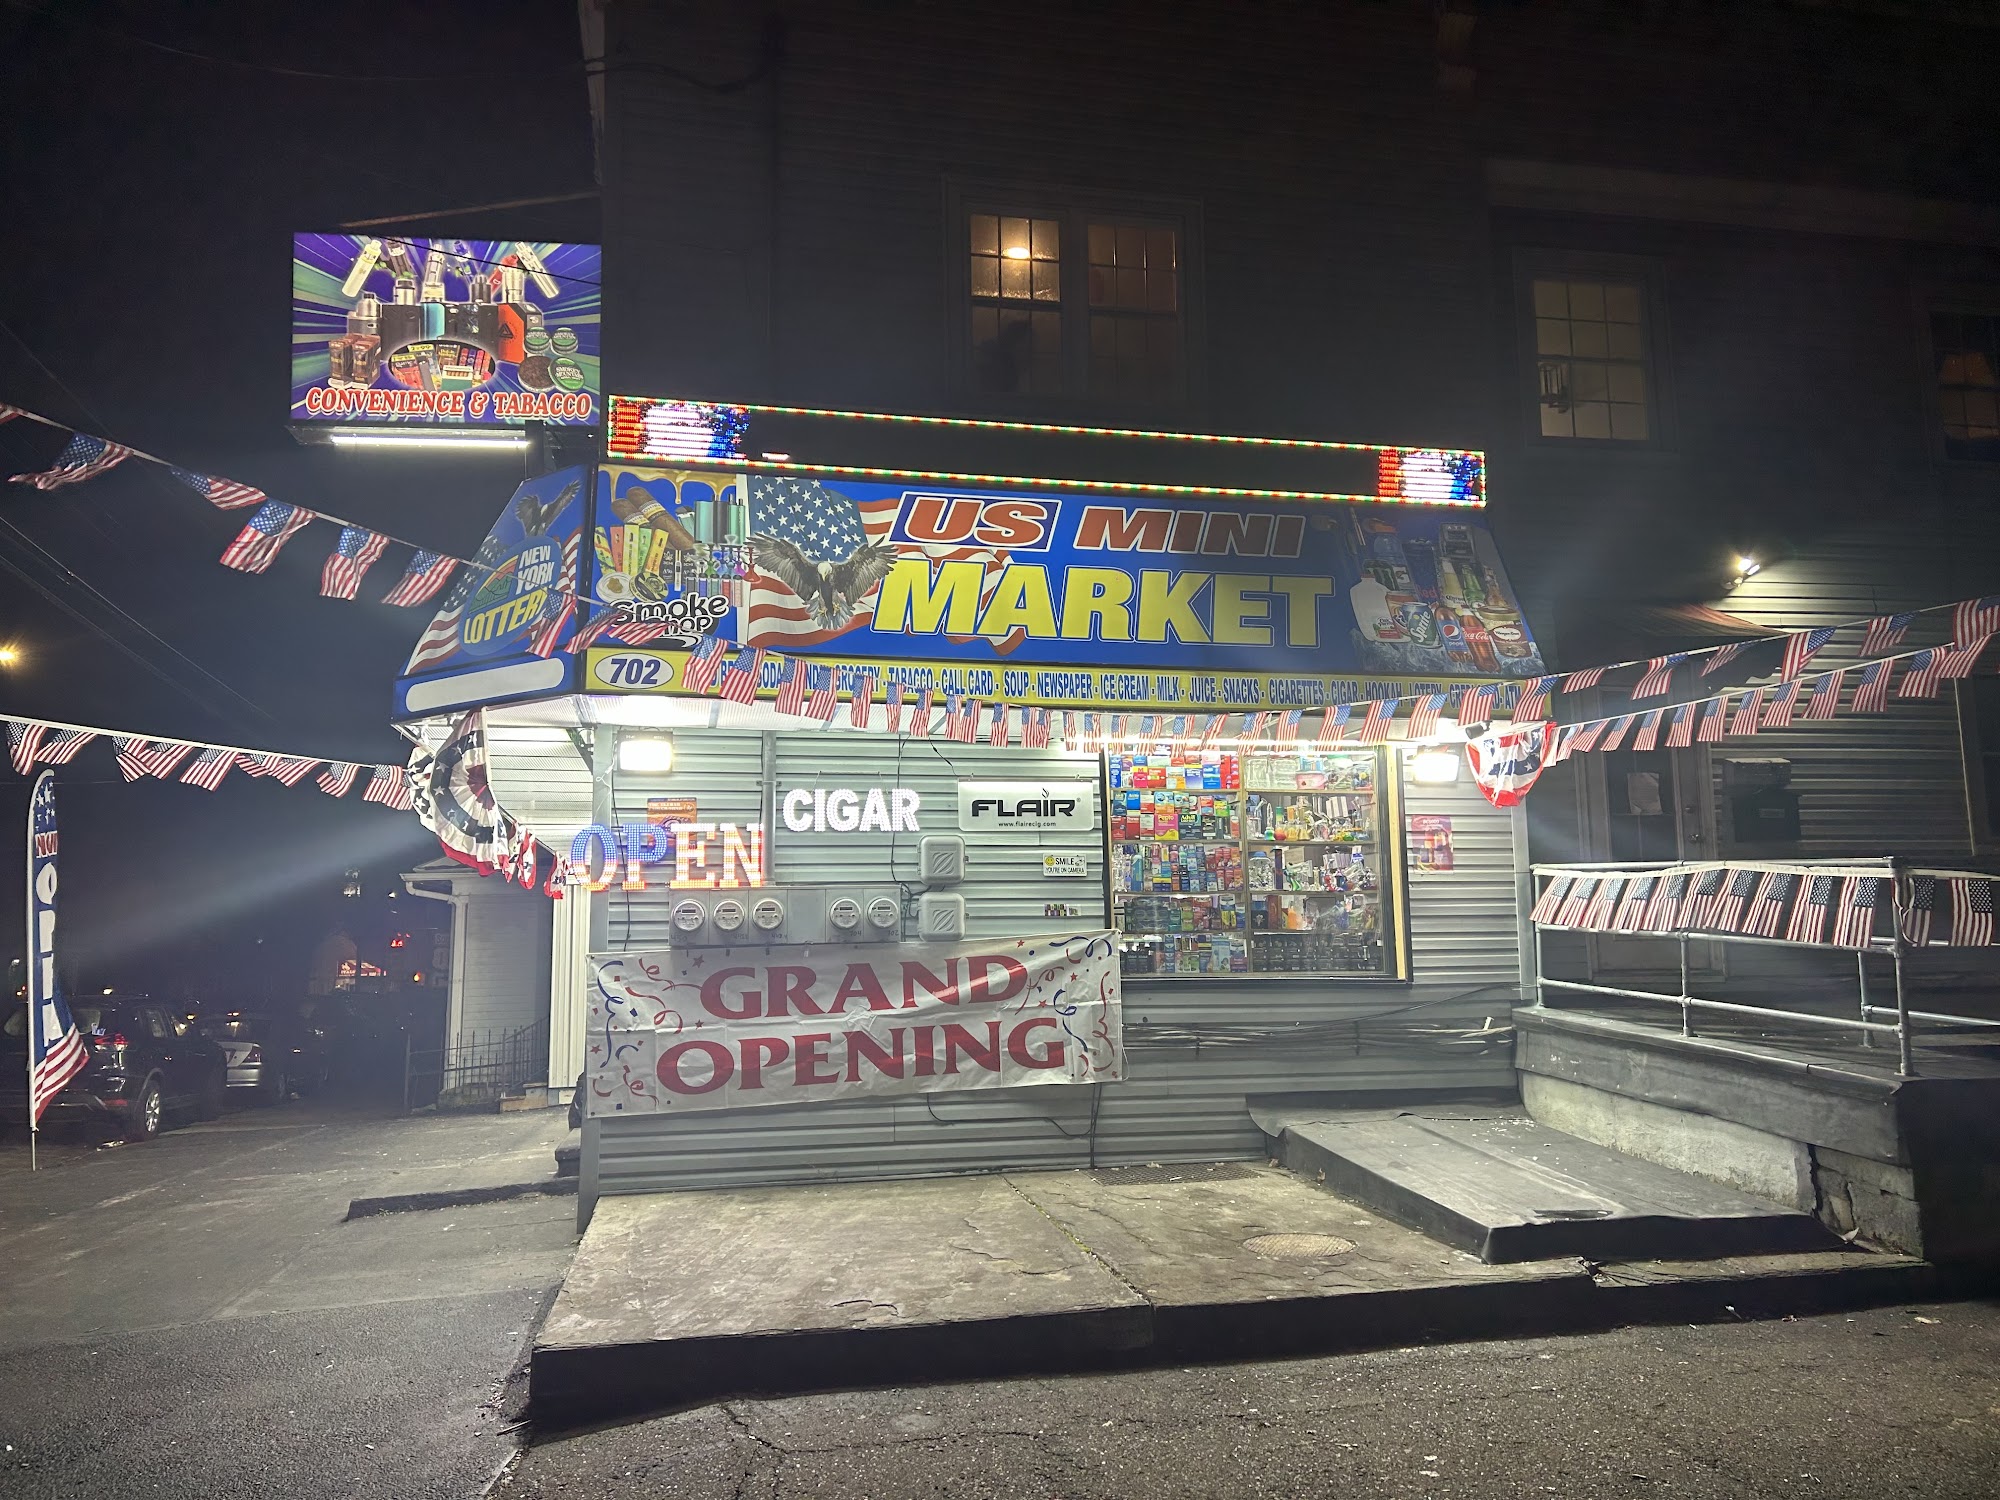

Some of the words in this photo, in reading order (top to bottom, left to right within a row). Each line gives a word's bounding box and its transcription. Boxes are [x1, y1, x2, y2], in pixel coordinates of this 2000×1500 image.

[306, 388, 464, 416] CONVENIENCE
[471, 391, 488, 416] &
[494, 392, 592, 419] TABACCO
[904, 497, 1047, 547] US
[1074, 506, 1305, 558] MINI
[519, 545, 551, 569] NEW
[516, 562, 555, 595] YORK
[611, 593, 729, 627] Smoke
[871, 558, 1335, 649] MARKET
[1410, 611, 1431, 642] Sprite
[610, 658, 661, 685] 702
[888, 666, 933, 694] TABACCO
[942, 668, 966, 695] CALL
[968, 669, 994, 696] CARD
[1004, 670, 1029, 698] SOUP
[1037, 672, 1093, 699] NEWSPAPER
[1100, 674, 1115, 700] ICE
[1118, 674, 1150, 701] CREAM
[1157, 676, 1180, 701] MILK
[1189, 677, 1217, 703] JUICE
[1223, 678, 1260, 704] SNACKS
[1269, 678, 1324, 705] CIGARETTES
[1331, 680, 1358, 706] CIGAR
[1365, 681, 1402, 707] HOOKAH
[782, 788, 921, 832] CIGAR
[971, 799, 1076, 817] FLAIR
[998, 820, 1057, 828] www.flairecig.com
[571, 823, 765, 892] OPEN
[1055, 857, 1074, 866] SMILE
[700, 954, 1027, 1019] GRAND
[656, 1017, 1066, 1095] OPENING
